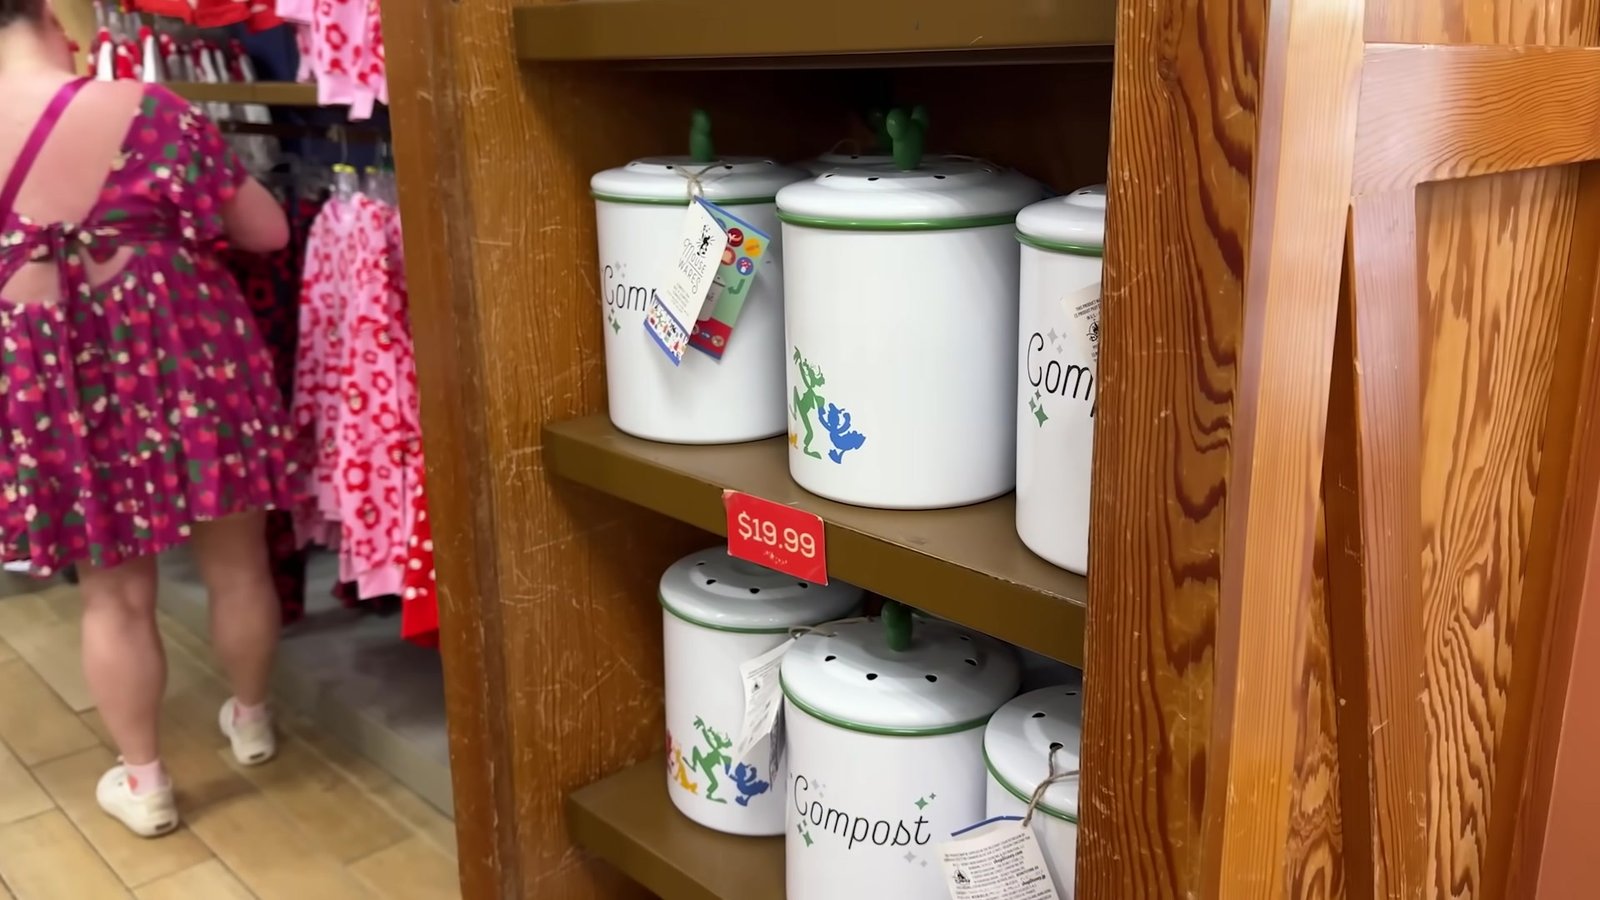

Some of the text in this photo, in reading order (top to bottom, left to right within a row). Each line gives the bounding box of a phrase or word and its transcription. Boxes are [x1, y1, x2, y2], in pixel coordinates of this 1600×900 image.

[1027, 332, 1096, 418] Com
[738, 510, 816, 559] $19.99
[794, 775, 931, 850] Compost
